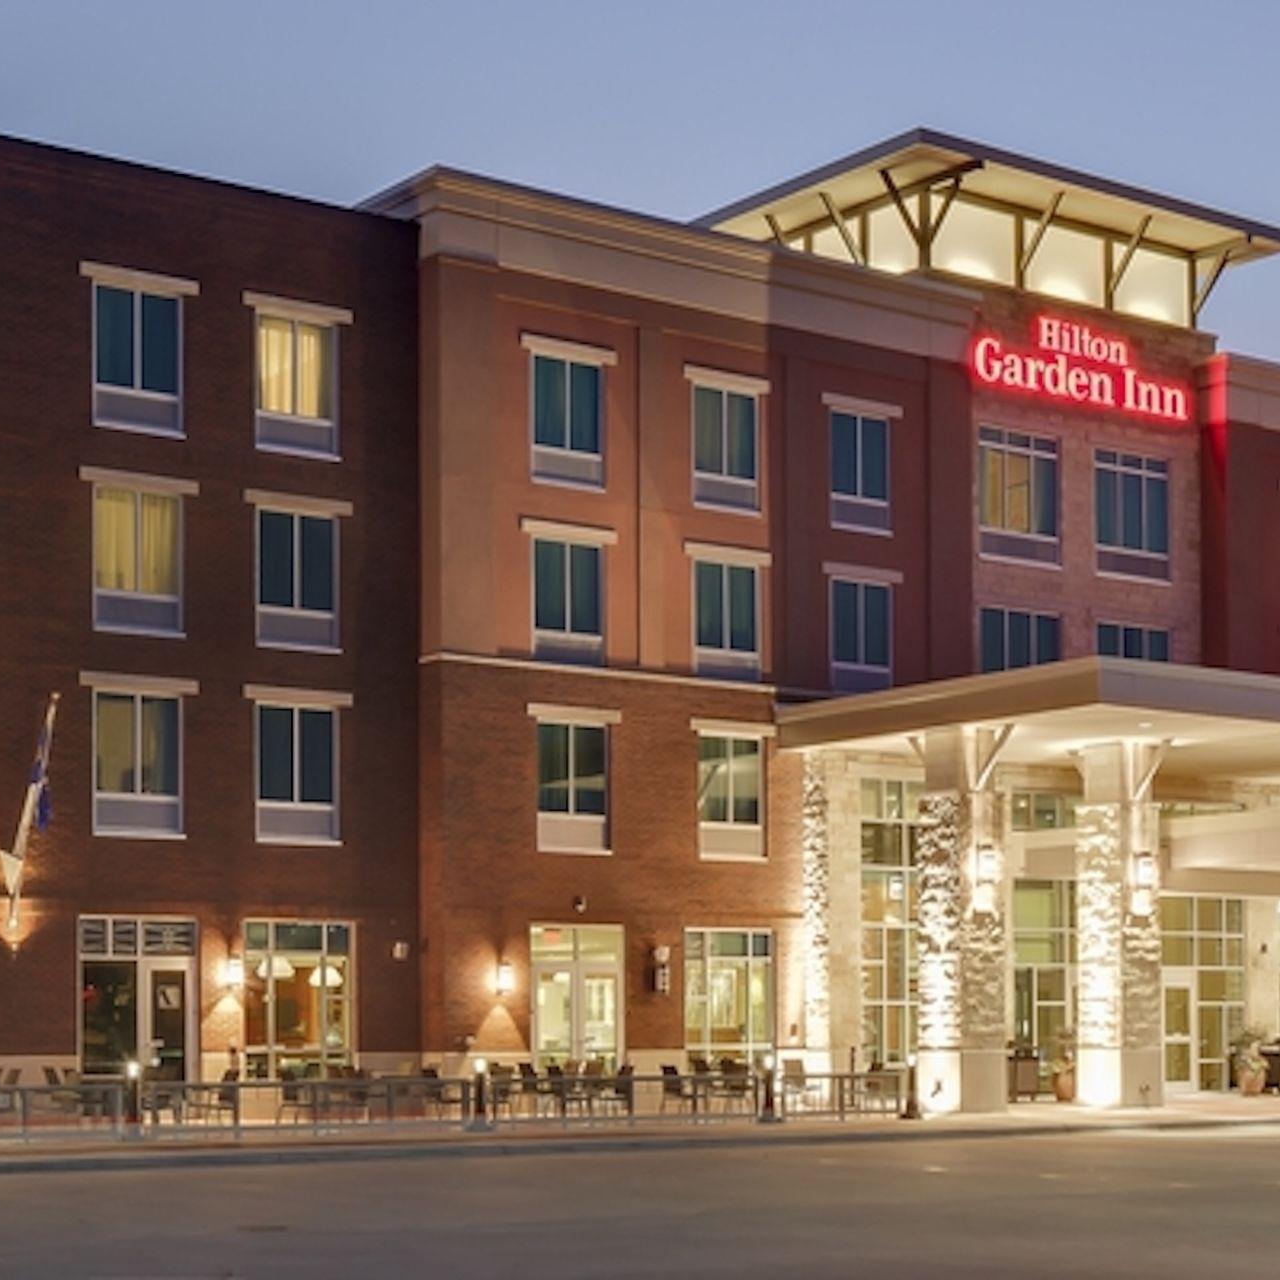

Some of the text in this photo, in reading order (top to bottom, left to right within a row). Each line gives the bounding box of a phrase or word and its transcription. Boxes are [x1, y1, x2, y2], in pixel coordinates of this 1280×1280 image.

[1038, 317, 1128, 366] Hilton
[973, 338, 1188, 420] Garden Inn
